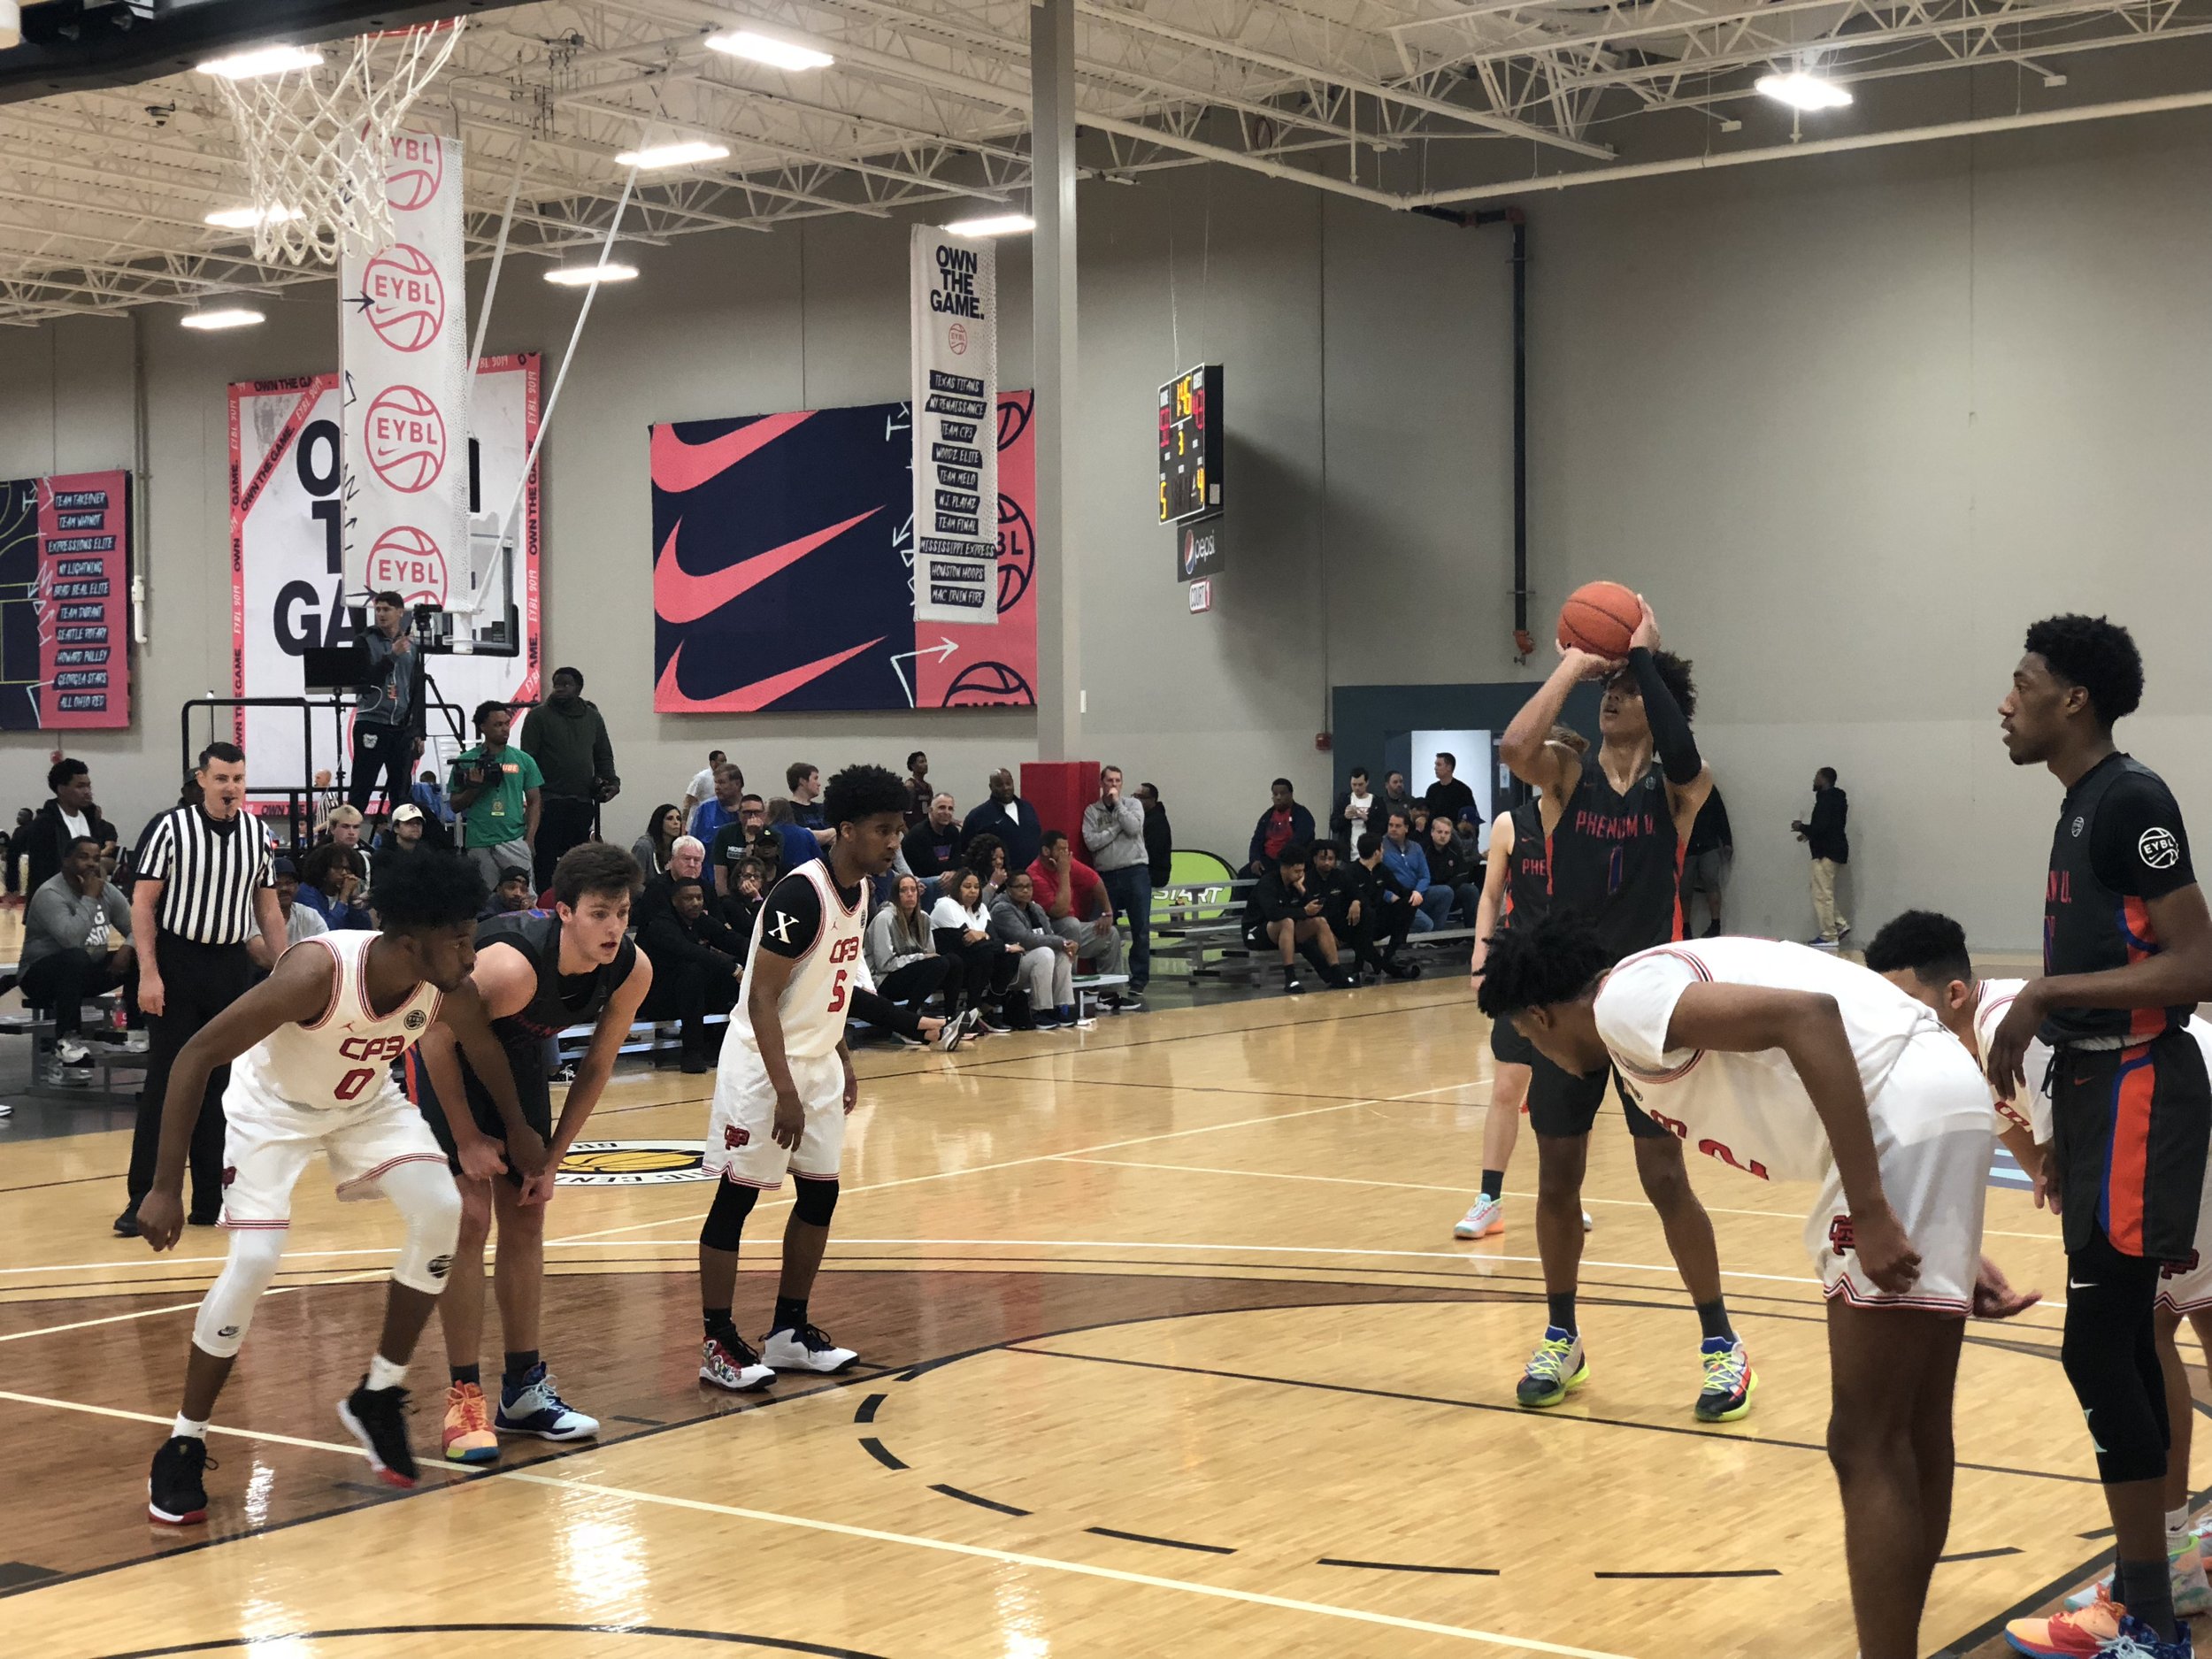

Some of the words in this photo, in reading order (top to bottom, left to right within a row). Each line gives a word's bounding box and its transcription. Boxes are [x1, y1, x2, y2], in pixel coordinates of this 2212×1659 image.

[373, 136, 434, 165] YBL
[936, 245, 978, 274] OWN
[375, 274, 435, 305] EYBL
[940, 268, 974, 296] THE
[930, 289, 985, 320] GAME.
[253, 379, 278, 392] OWN
[278, 377, 299, 390] THE
[935, 374, 956, 389] TEXAS
[956, 378, 980, 393] TITANS
[930, 396, 938, 409] NY
[939, 398, 984, 416] RENAISSANCE
[377, 418, 438, 445] EYBL
[942, 423, 958, 437] TEAM
[959, 426, 973, 439] CP3
[959, 449, 979, 464] ELITE
[241, 483, 260, 511] OWN
[257, 460, 273, 484] THE
[270, 426, 296, 463] GAME.
[941, 469, 956, 482] TEAM
[957, 472, 976, 485] MELO
[56, 494, 73, 508] TEAM
[73, 492, 105, 505] TAKEOVER
[528, 488, 537, 517] THE
[59, 515, 76, 529] TEAM
[938, 516, 956, 528] TEAM
[956, 518, 977, 531] FINAL
[48, 539, 92, 553] EXPRESSIONS
[93, 536, 113, 549] ELITE
[920, 540, 964, 556] MISSISSIPPI
[965, 542, 995, 557] EXPRESS
[1194, 529, 1216, 565] pepsi
[379, 559, 439, 585] EYBL
[932, 564, 961, 578] HOUSTON
[962, 566, 984, 580] HOOPS
[89, 581, 109, 595] ELITE
[932, 589, 947, 602] MAC
[948, 590, 968, 603] IRVIN
[968, 591, 984, 603] FIRE
[60, 607, 78, 619] TEAM
[58, 627, 83, 641] SEATTLE
[83, 649, 108, 663] PULLEY
[58, 673, 87, 687] GEORGIA
[88, 672, 107, 685] STARS
[60, 696, 73, 709] ALL
[73, 695, 90, 708] OHIO
[1575, 810, 1639, 840] PHENOM
[2143, 838, 2173, 855] EYBL
[767, 910, 800, 944] X
[829, 936, 859, 964] CP3
[827, 969, 848, 1013] 5
[339, 1035, 405, 1062] CP3
[334, 1068, 376, 1100] 0
